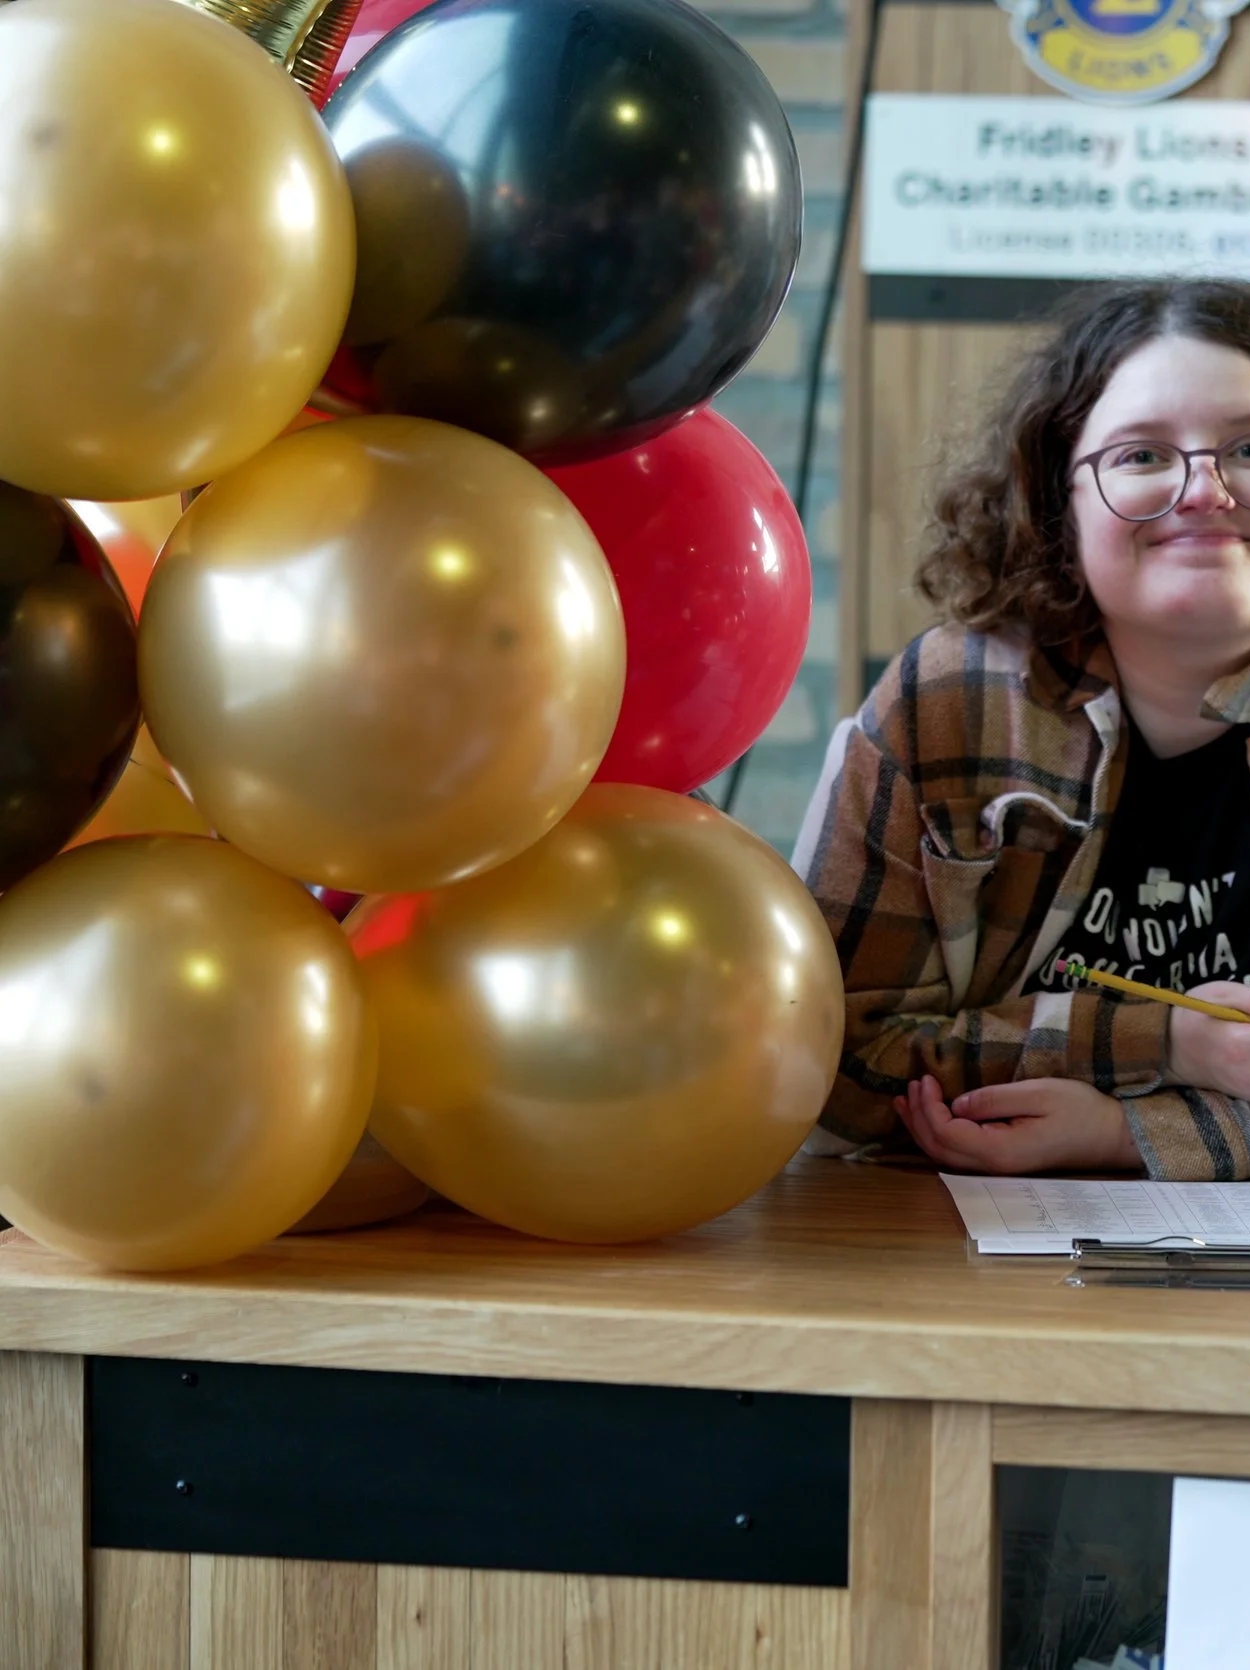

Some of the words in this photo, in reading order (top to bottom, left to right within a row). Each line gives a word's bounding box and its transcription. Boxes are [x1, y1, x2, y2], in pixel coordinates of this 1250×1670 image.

[976, 121, 1124, 169] Fridley
[1133, 124, 1250, 162] Lions
[893, 170, 1118, 209] Charitable
